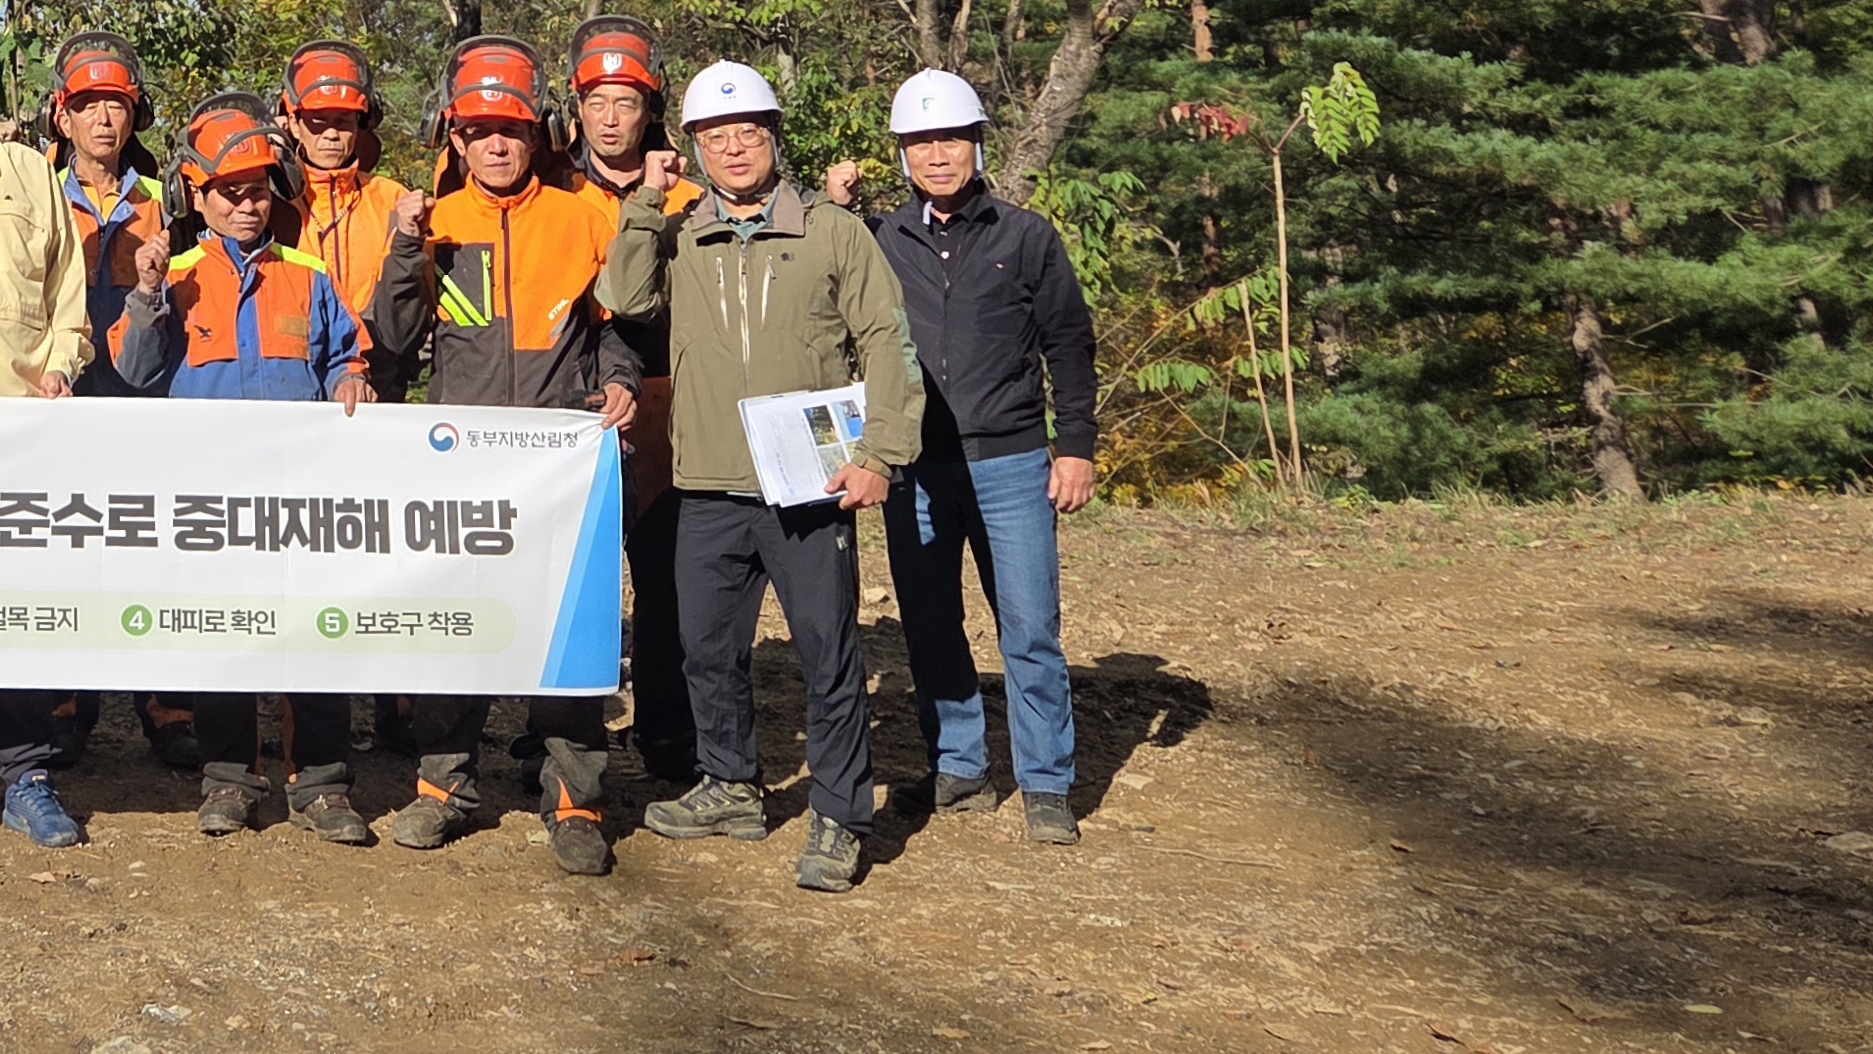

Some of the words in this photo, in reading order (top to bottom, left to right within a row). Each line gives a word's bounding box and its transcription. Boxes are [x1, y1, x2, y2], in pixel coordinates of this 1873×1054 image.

[466, 430, 579, 448] 동부지방산림청
[172, 494, 391, 555] 중대재해
[404, 499, 518, 556] 예방
[34, 607, 78, 632] 금지
[129, 610, 145, 630] 4
[159, 608, 227, 634] 대피로
[230, 609, 276, 636] 확인
[325, 612, 340, 632] 5
[355, 611, 424, 636] 보호구
[427, 611, 474, 636] 착용
